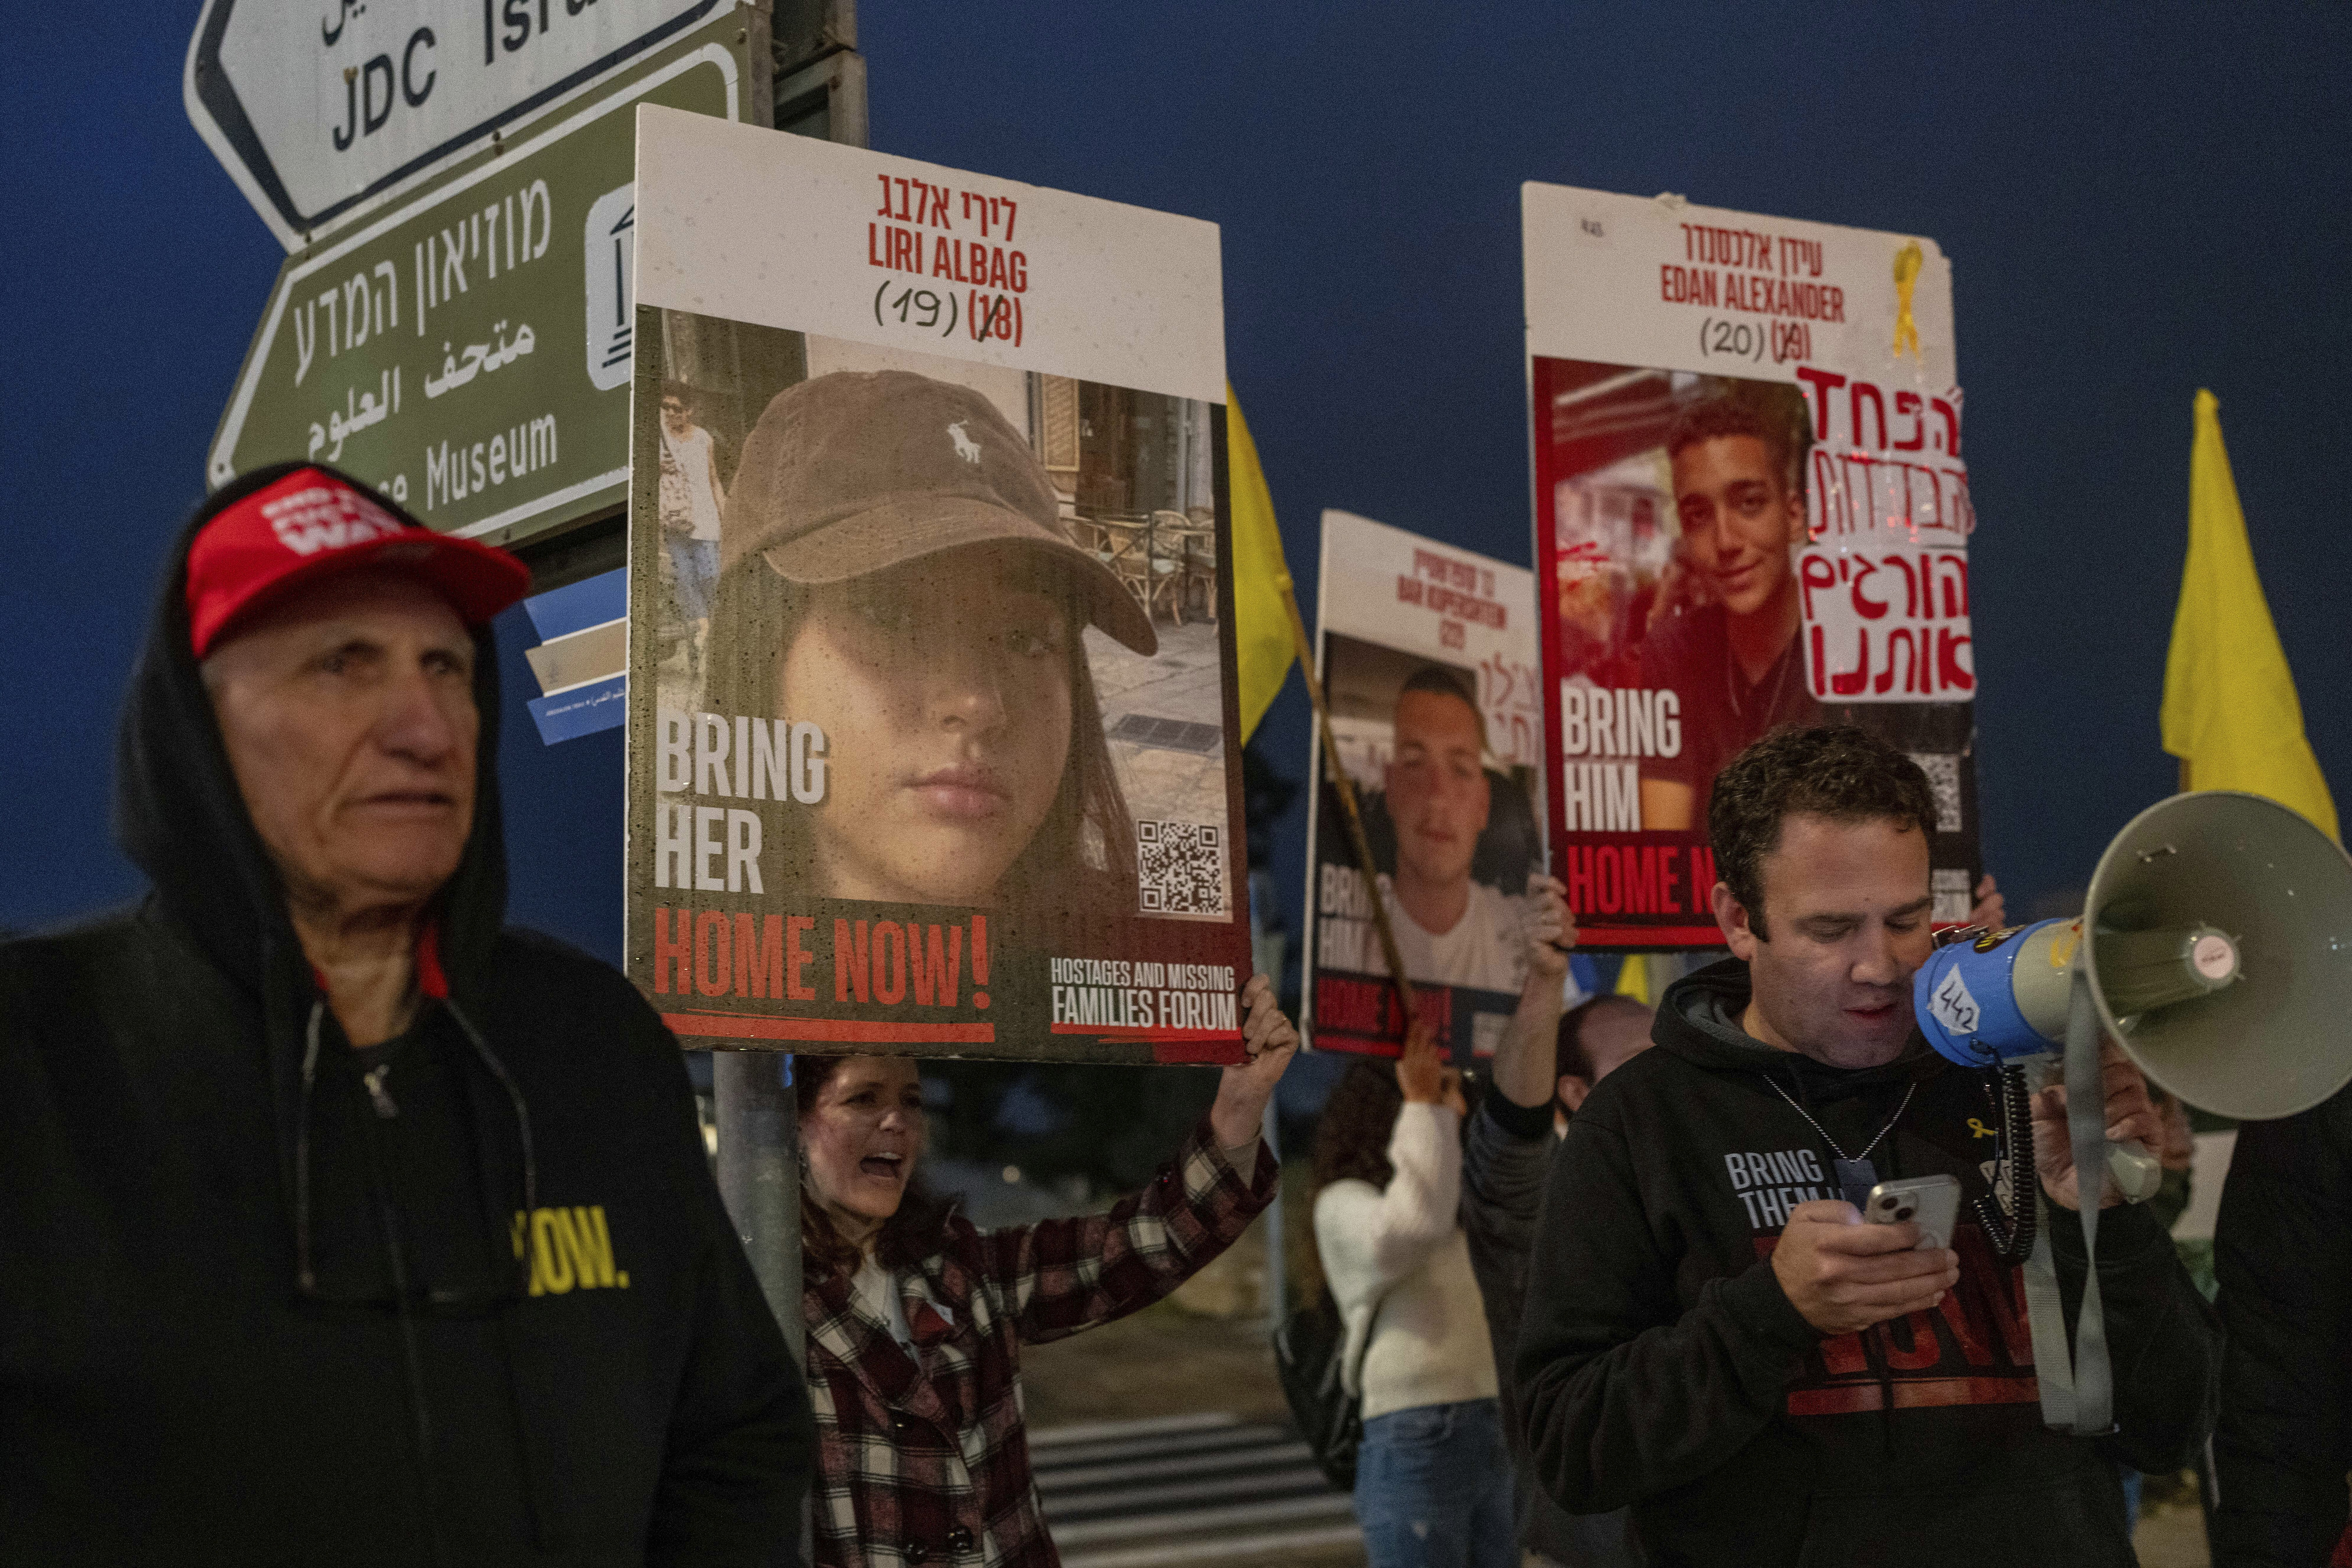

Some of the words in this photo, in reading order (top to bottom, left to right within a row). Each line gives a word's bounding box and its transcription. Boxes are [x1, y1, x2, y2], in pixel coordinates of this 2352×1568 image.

[332, 26, 436, 152] JDC
[878, 174, 951, 230] אלבג
[960, 191, 1017, 242] לירי
[416, 179, 551, 337] מוזיאון
[869, 222, 923, 274] LIRI
[933, 236, 1027, 293] ALBAG
[1778, 236, 1823, 277] עידן
[294, 260, 398, 387] המדע
[874, 280, 958, 338] (19)
[1661, 264, 1718, 307] EDAN
[1724, 272, 1845, 323] ALEXANDER
[424, 319, 535, 399] متحف
[1700, 317, 1765, 363] (20)
[308, 366, 400, 462] العلوم
[426, 414, 557, 511] Museum
[655, 709, 826, 804] BRING
[1561, 686, 1682, 759] BRING
[1564, 762, 1640, 832] HIM
[655, 802, 764, 894] HER
[1568, 844, 1681, 914] HOME
[655, 907, 815, 1001] HOME
[834, 915, 991, 1009] NOW!
[1051, 957, 1131, 987] HOSTAGES
[1134, 962, 1165, 988] AND
[1167, 963, 1235, 991] MISSING
[1052, 985, 1154, 1029] FAMILIES
[1158, 990, 1237, 1031] FORUM
[1724, 1149, 1824, 1190] BRING
